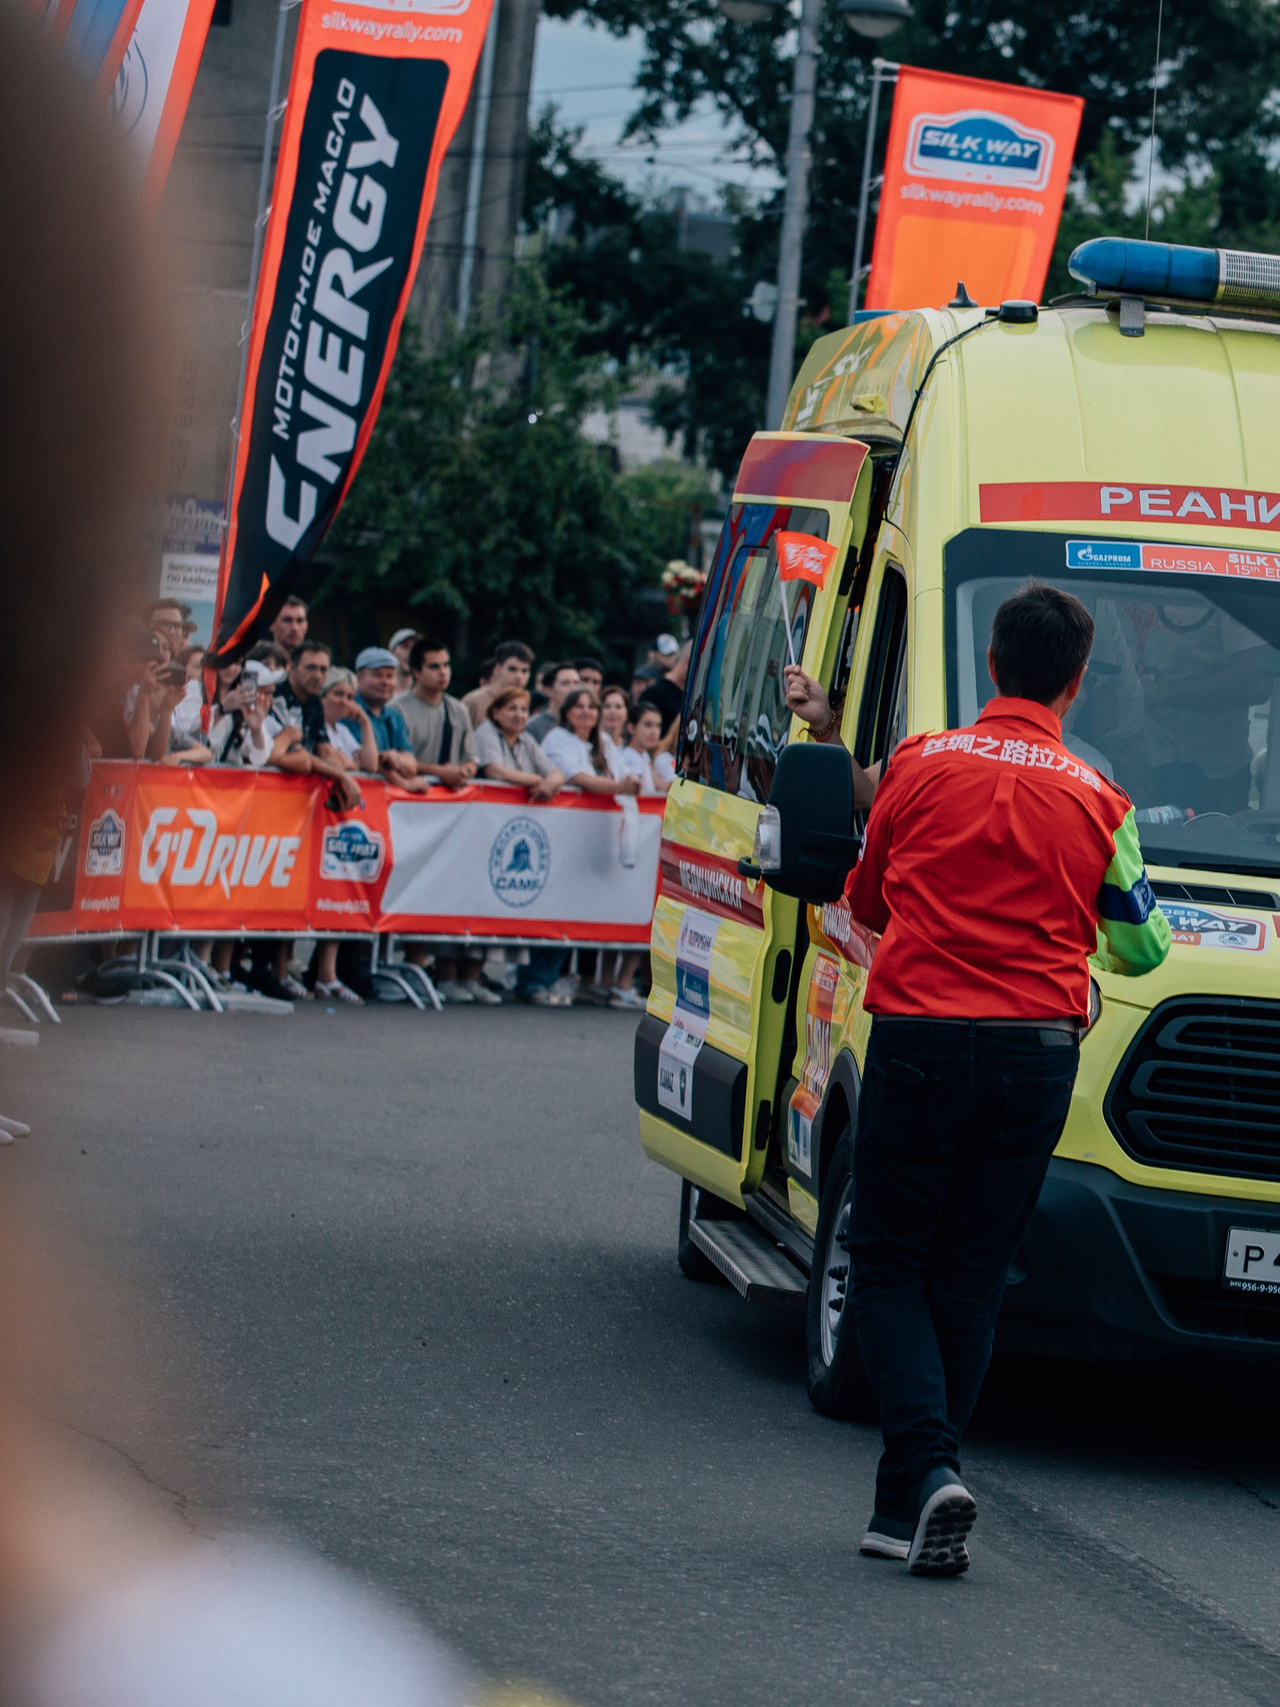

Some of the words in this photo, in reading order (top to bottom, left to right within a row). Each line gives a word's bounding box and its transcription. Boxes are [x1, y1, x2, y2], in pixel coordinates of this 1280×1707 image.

[321, 10, 463, 43] silkwayrally.com
[921, 129, 983, 151] SILK
[986, 139, 1039, 159] WAY
[900, 183, 1045, 216] silkwayrally.com
[272, 218, 322, 441] МОТОРНОЕ
[313, 77, 356, 214] МАСЛО
[1151, 558, 1216, 573] RUSSIA
[1234, 564, 1260, 576] 15th
[1228, 553, 1269, 567] SILK
[921, 734, 1102, 792] 丝绸之路拉力赛
[1161, 908, 1199, 917] 025
[1179, 916, 1249, 932] WAY
